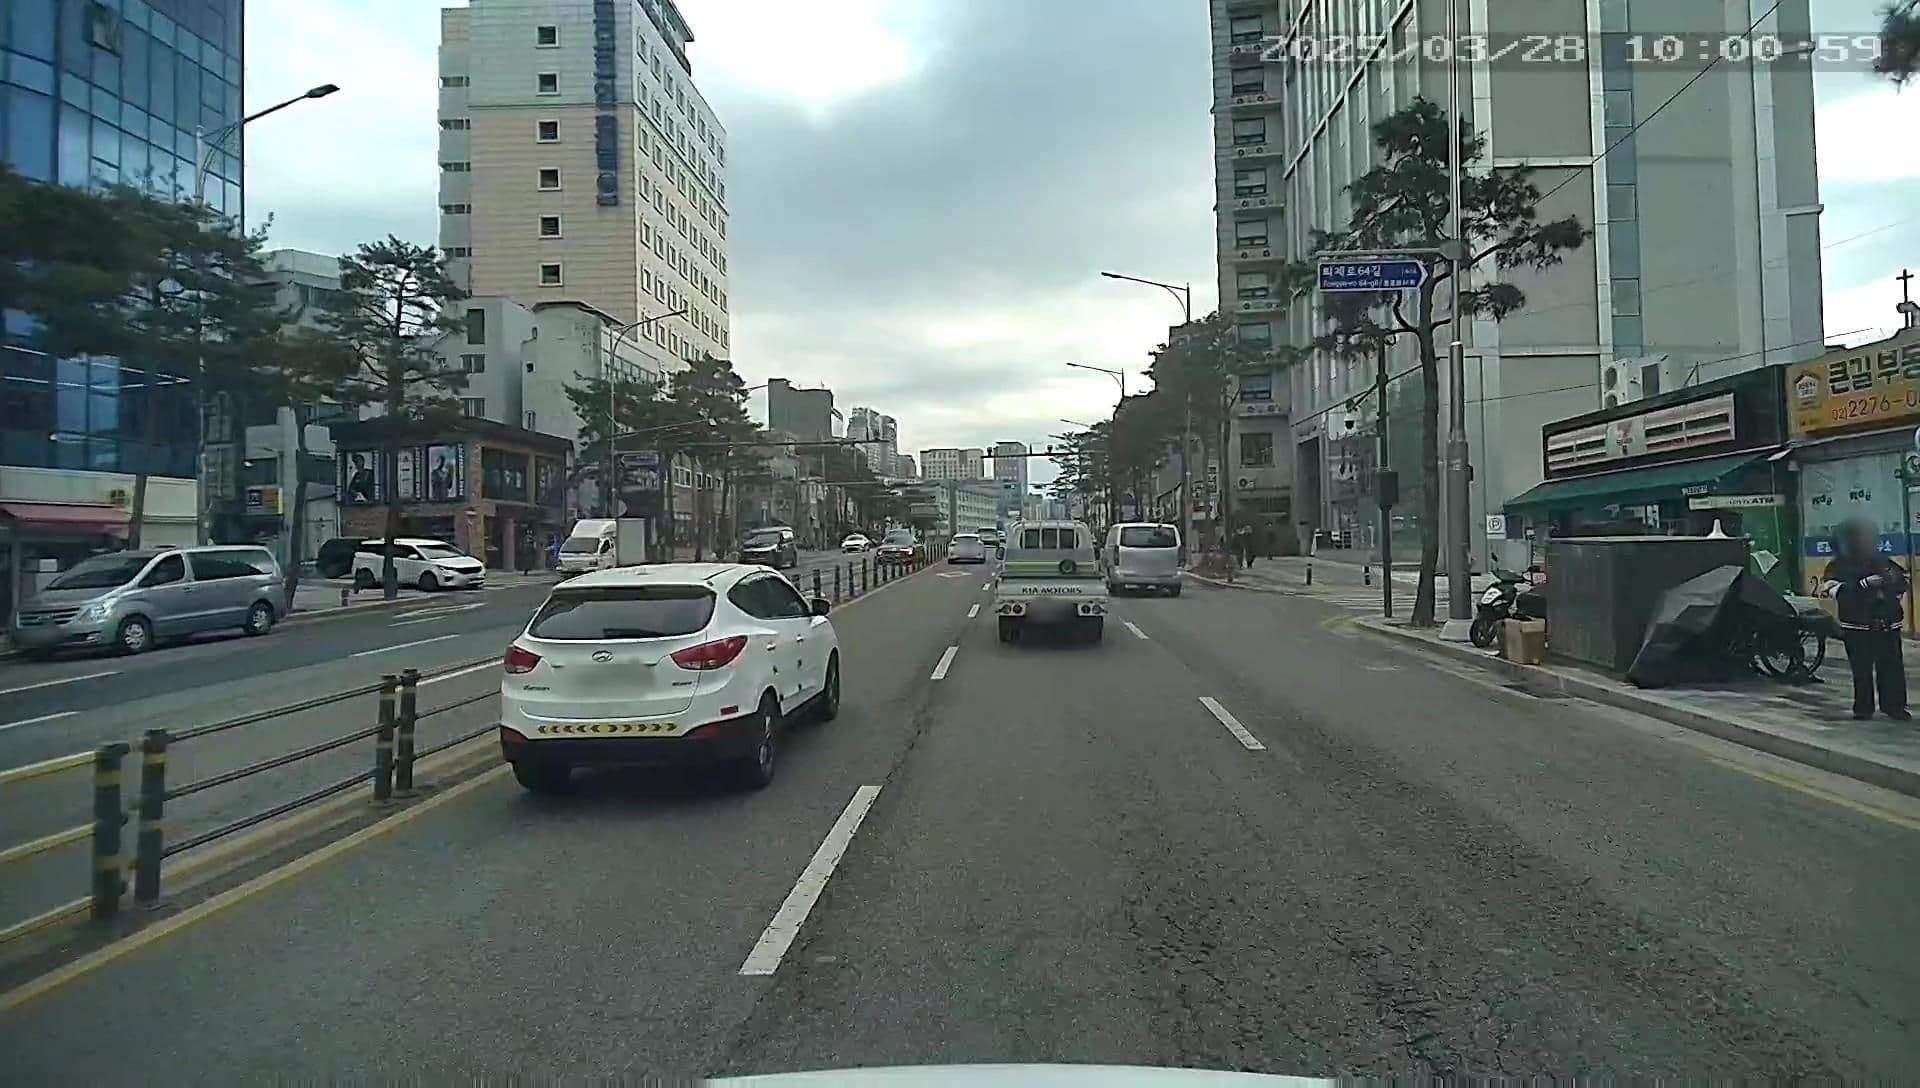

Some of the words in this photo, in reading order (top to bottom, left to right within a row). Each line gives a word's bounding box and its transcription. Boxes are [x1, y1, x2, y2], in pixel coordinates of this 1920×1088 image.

[1831, 389, 1920, 421] 02)2276-0
[1022, 586, 1039, 594] KIA
[1041, 586, 1083, 594] MOTORS
